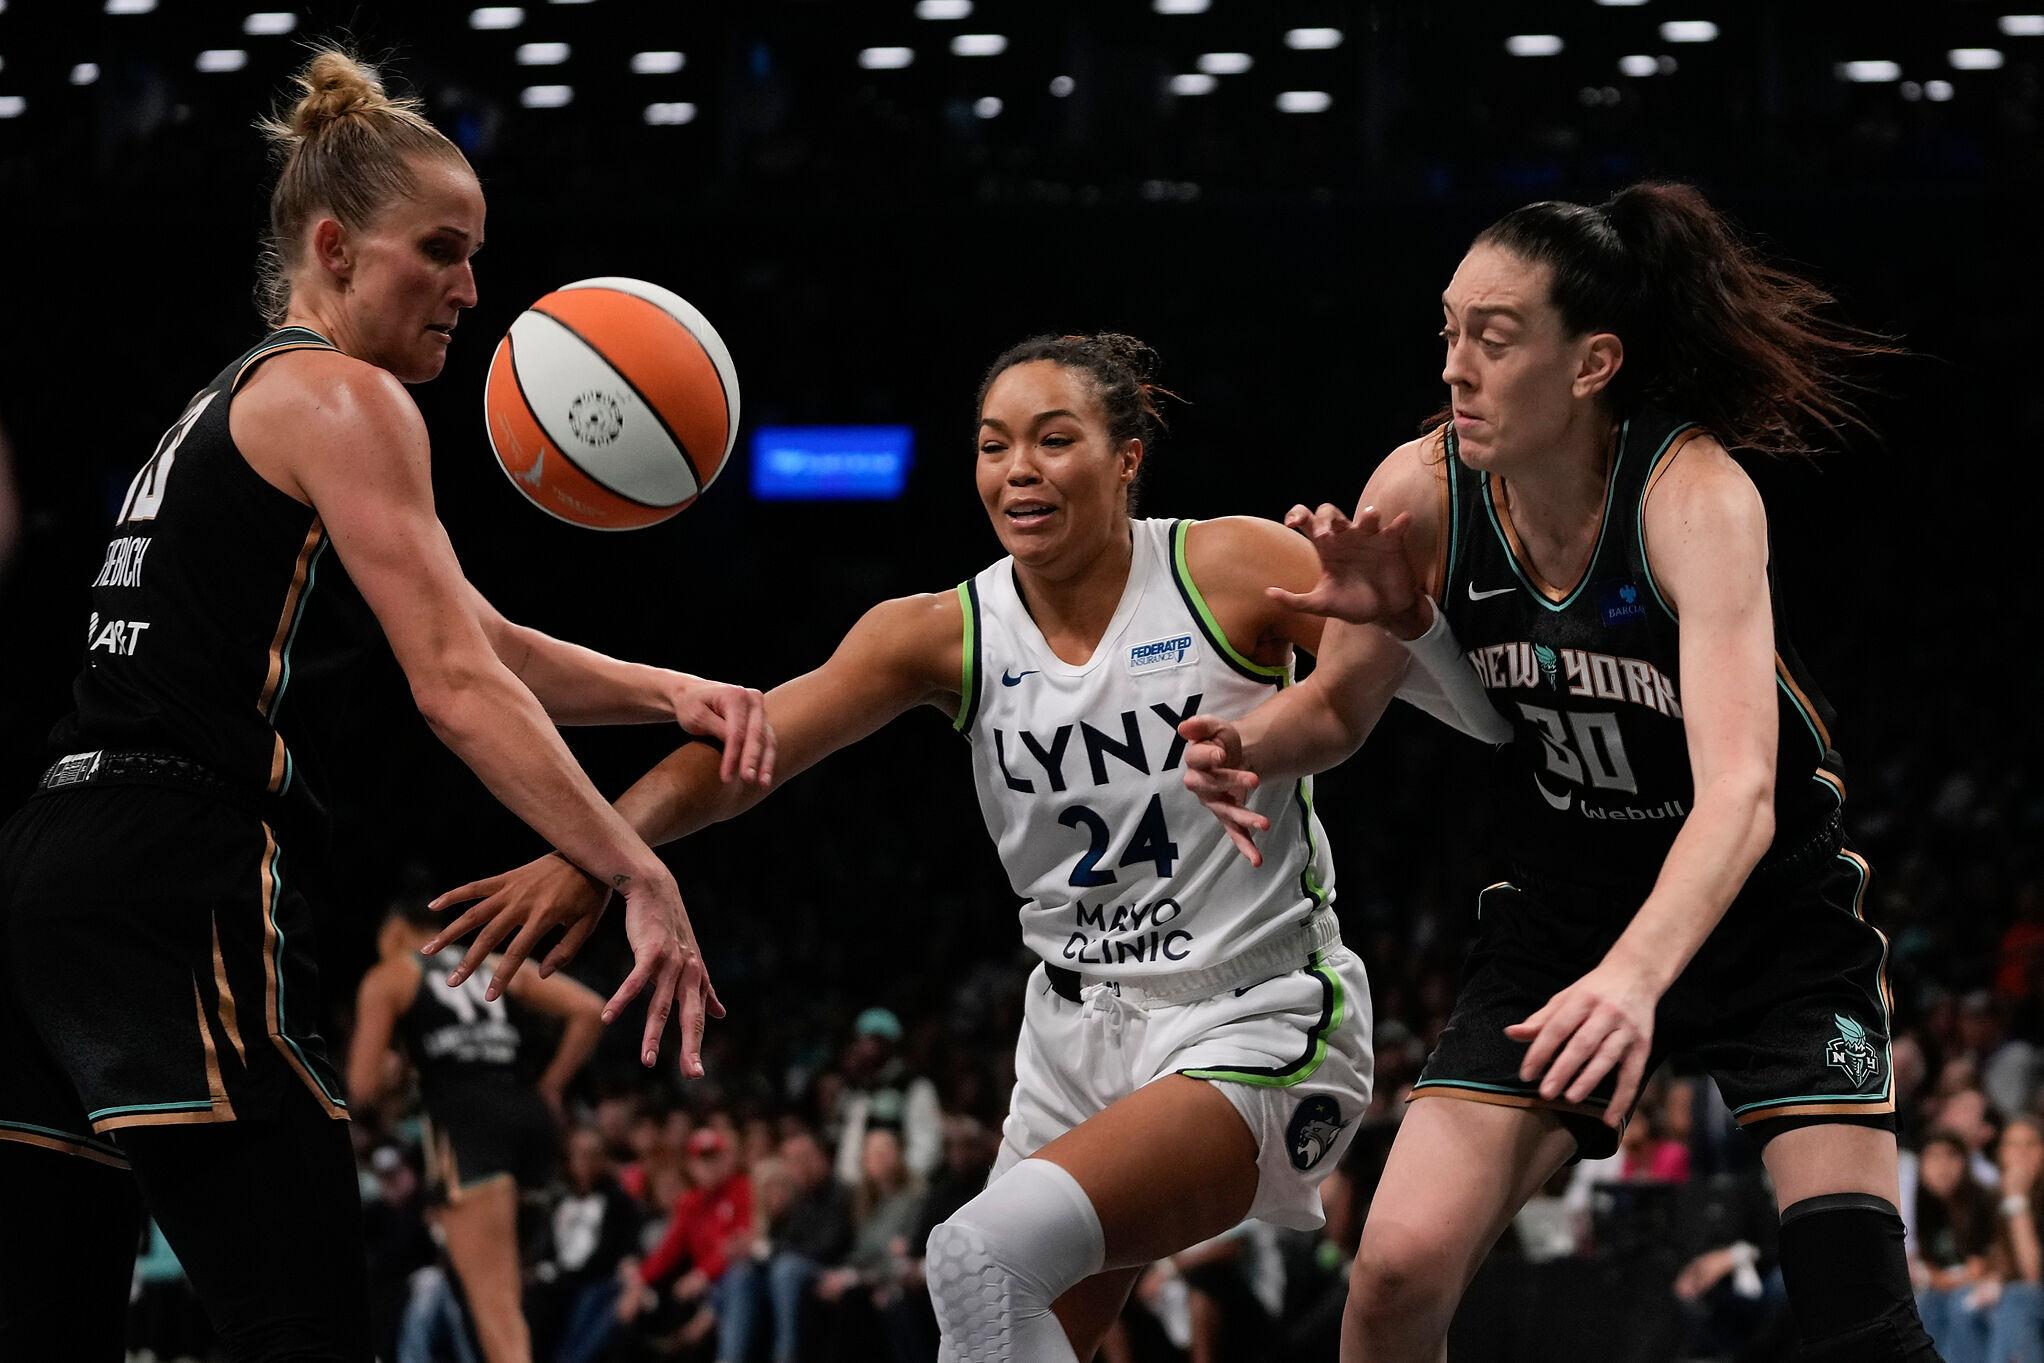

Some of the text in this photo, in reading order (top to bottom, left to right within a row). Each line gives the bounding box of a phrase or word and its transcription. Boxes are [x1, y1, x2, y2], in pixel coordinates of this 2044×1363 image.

[1130, 651, 1174, 668] INSURANCE
[1131, 636, 1192, 660] FEDERATED
[1467, 641, 1684, 719] NEW YORK
[993, 693, 1203, 793] LYNX
[1515, 701, 1638, 795] 30
[1580, 800, 1685, 820] Webull
[1058, 793, 1179, 887] 24
[1076, 898, 1181, 932] MAYO
[1063, 930, 1194, 964] CLINIC
